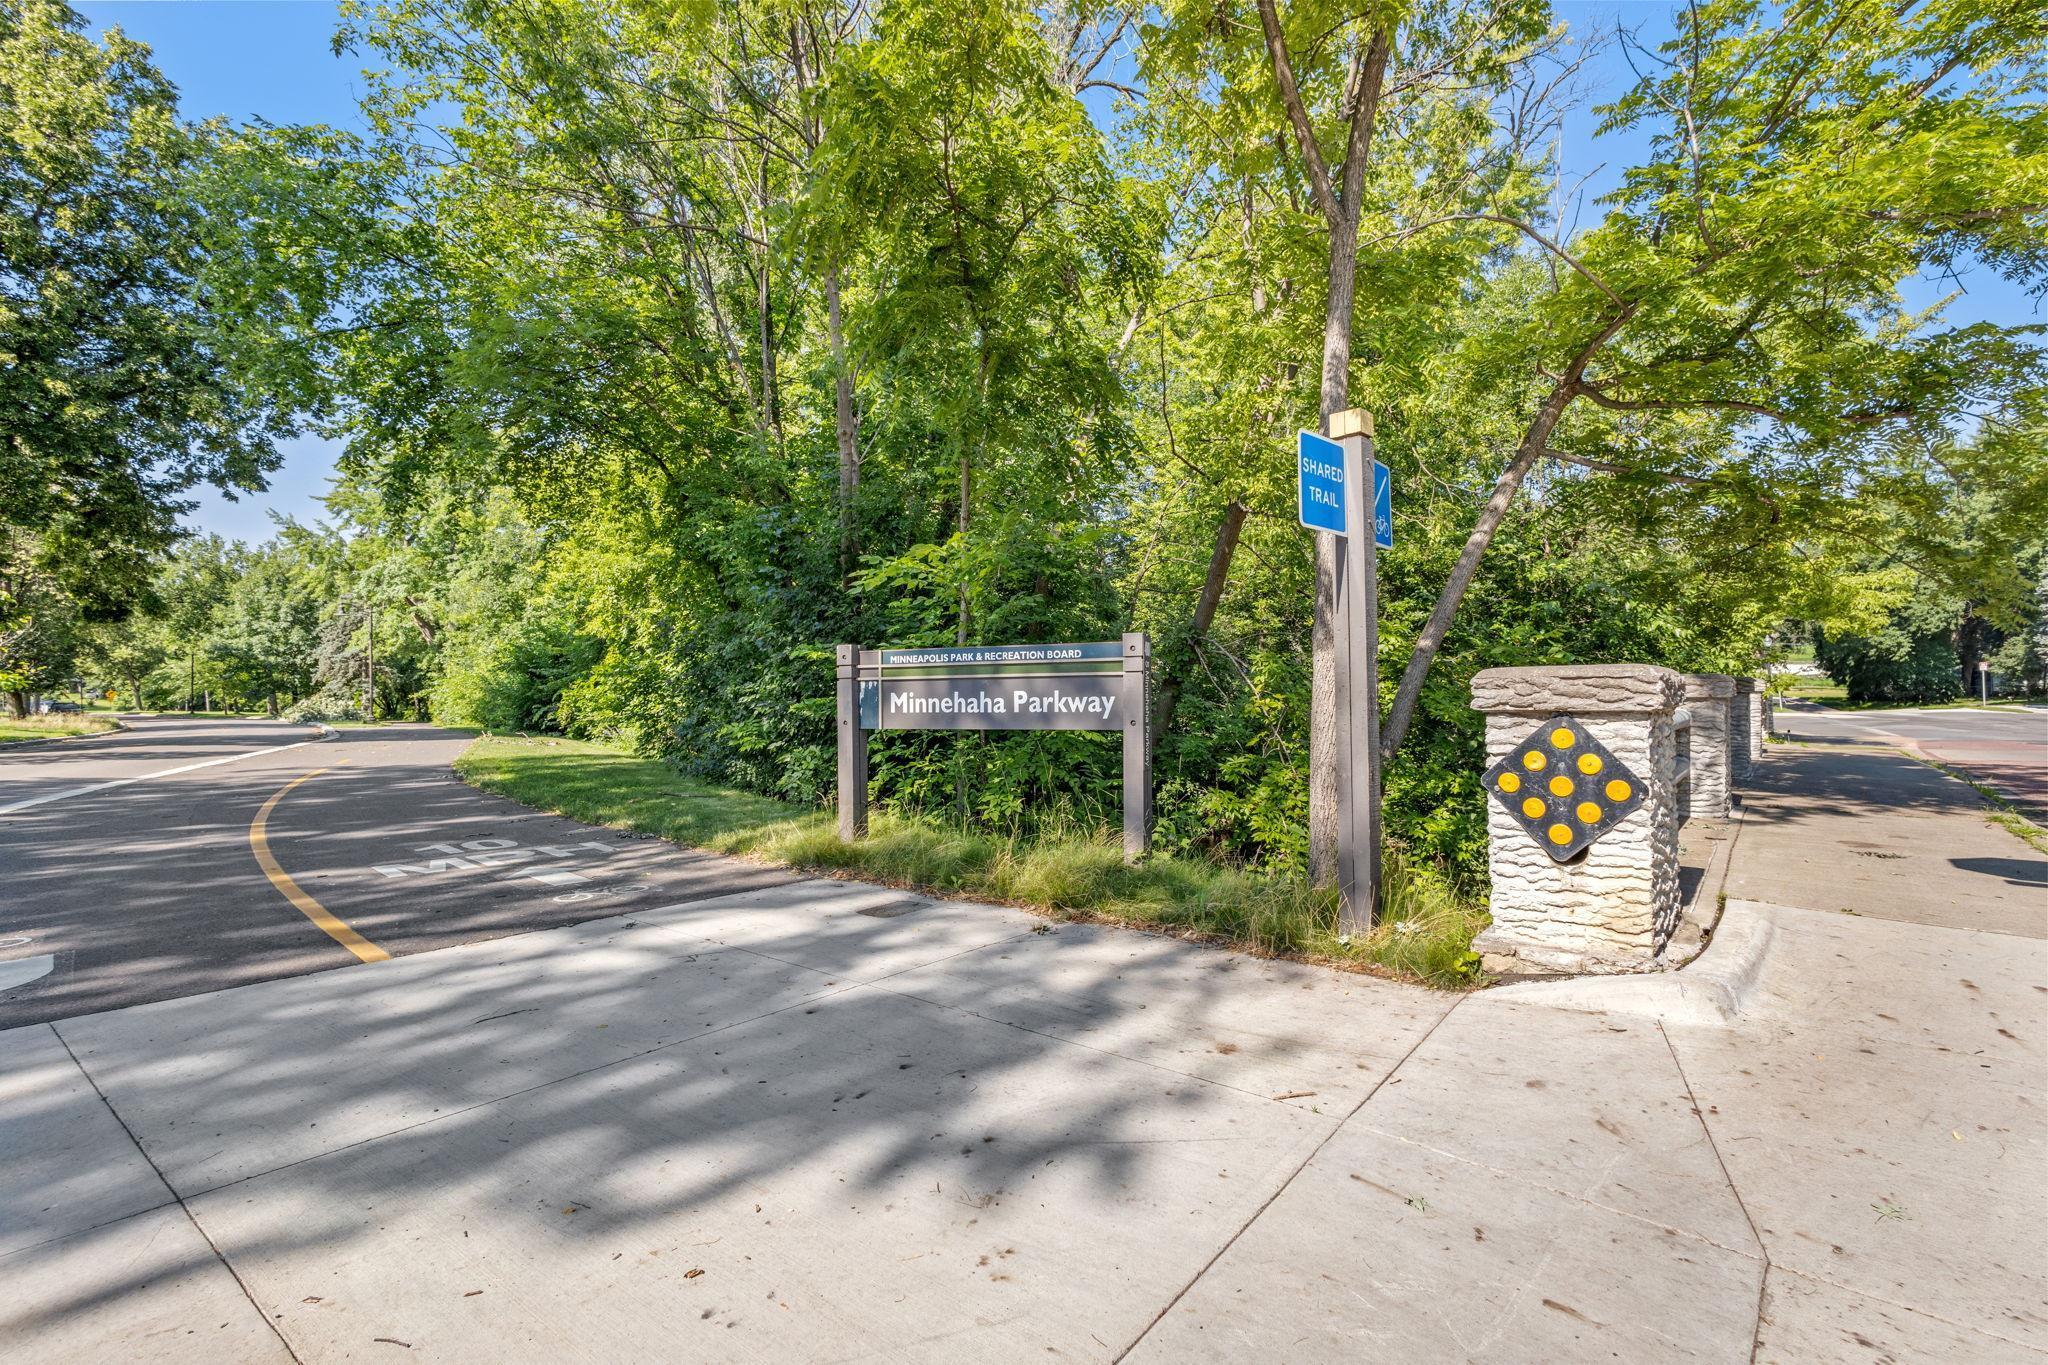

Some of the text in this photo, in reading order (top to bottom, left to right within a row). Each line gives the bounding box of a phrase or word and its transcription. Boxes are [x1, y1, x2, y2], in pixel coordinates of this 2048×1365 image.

[1302, 457, 1343, 483] SHARED
[1308, 486, 1339, 508] TRAIL
[890, 649, 1082, 664] MINNEAPOLIS PARK & RECREATION BOARD
[890, 690, 1116, 720] Minnehaha Parkway
[414, 838, 518, 855] 10
[371, 841, 621, 879] MPH
